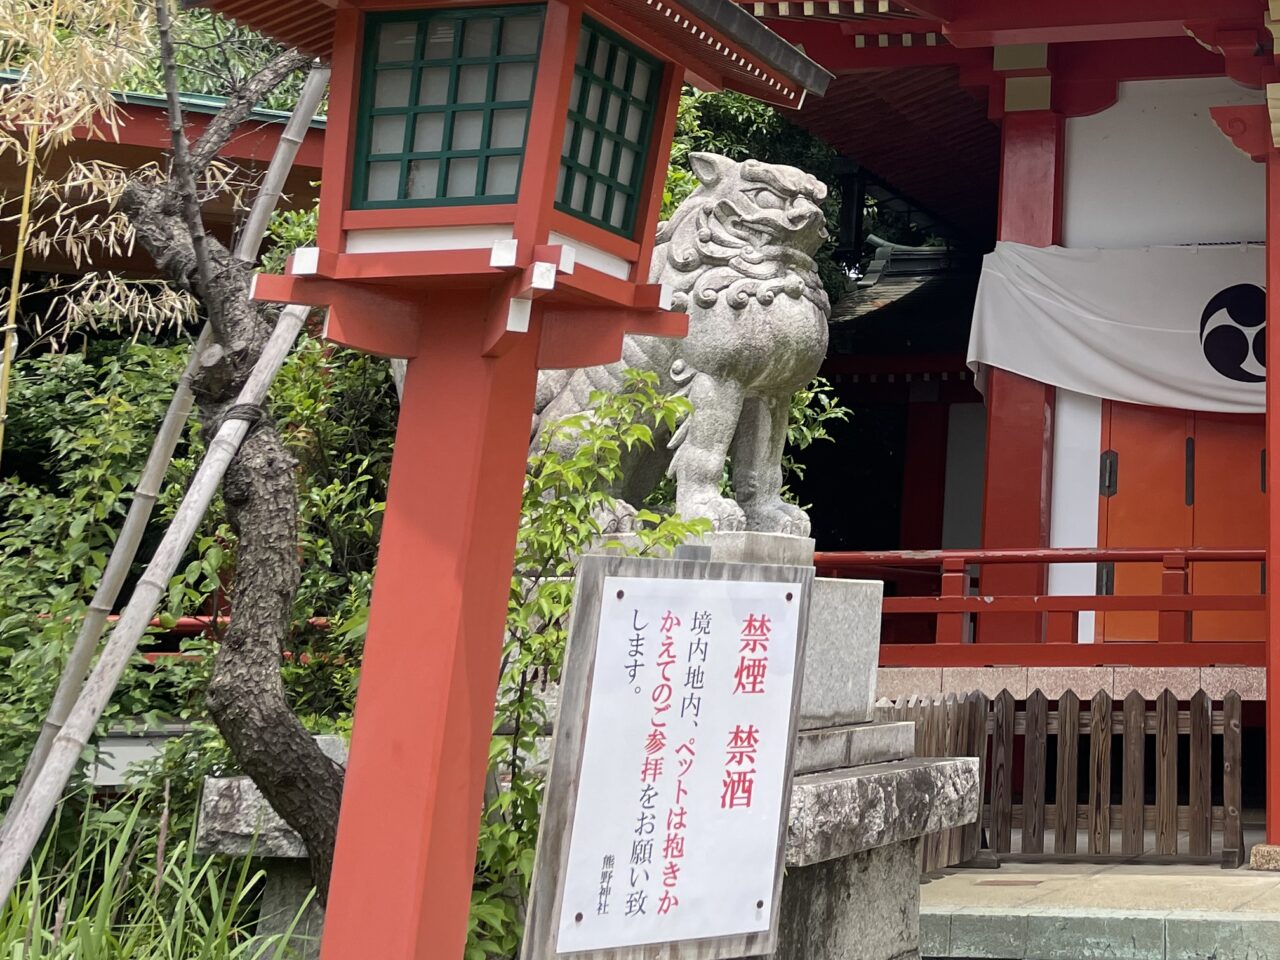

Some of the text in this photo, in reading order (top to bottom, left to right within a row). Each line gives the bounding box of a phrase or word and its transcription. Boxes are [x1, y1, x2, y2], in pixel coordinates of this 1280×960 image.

[624, 608, 649, 695] します。
[720, 612, 772, 810] 禁煙 禁酒
[623, 609, 682, 917] かえてのご参拝をお願い致
[656, 610, 712, 916] 境内地内、ペットは抱きか
[597, 853, 615, 916] 熊野神社
